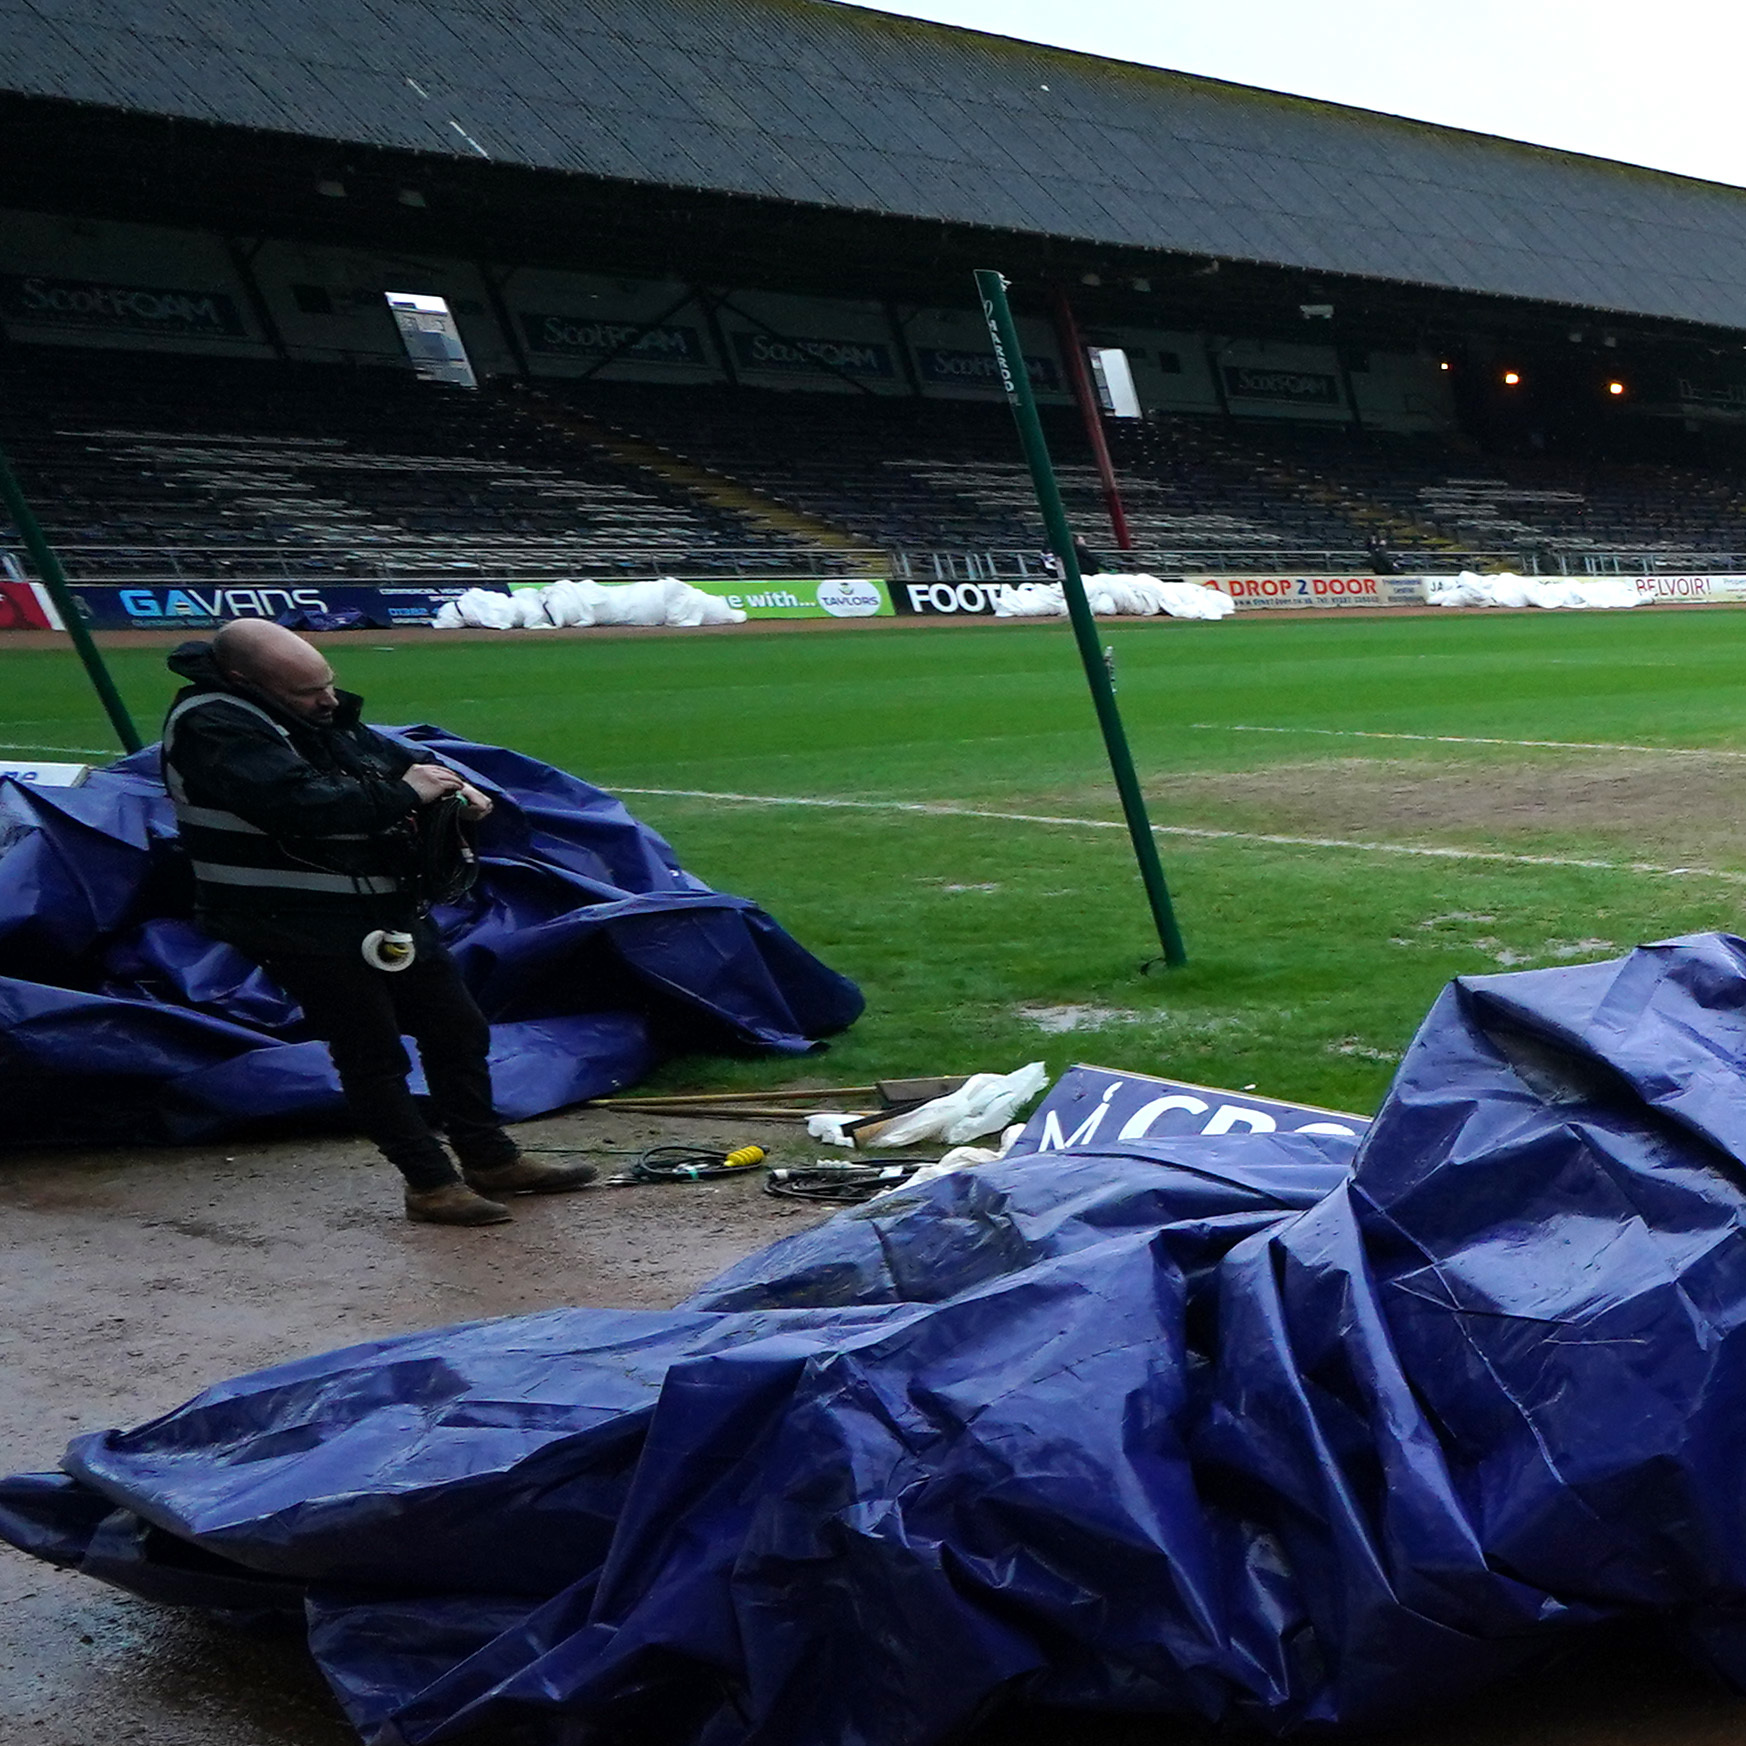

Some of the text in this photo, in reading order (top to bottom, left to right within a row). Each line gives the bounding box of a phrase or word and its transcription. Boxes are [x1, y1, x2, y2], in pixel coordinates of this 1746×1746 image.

[1228, 579, 1292, 596] DROP
[1296, 579, 1309, 595] 2
[1313, 579, 1377, 595] DOOR
[118, 588, 328, 617] GAVANS
[820, 595, 879, 607] TAYLORS
